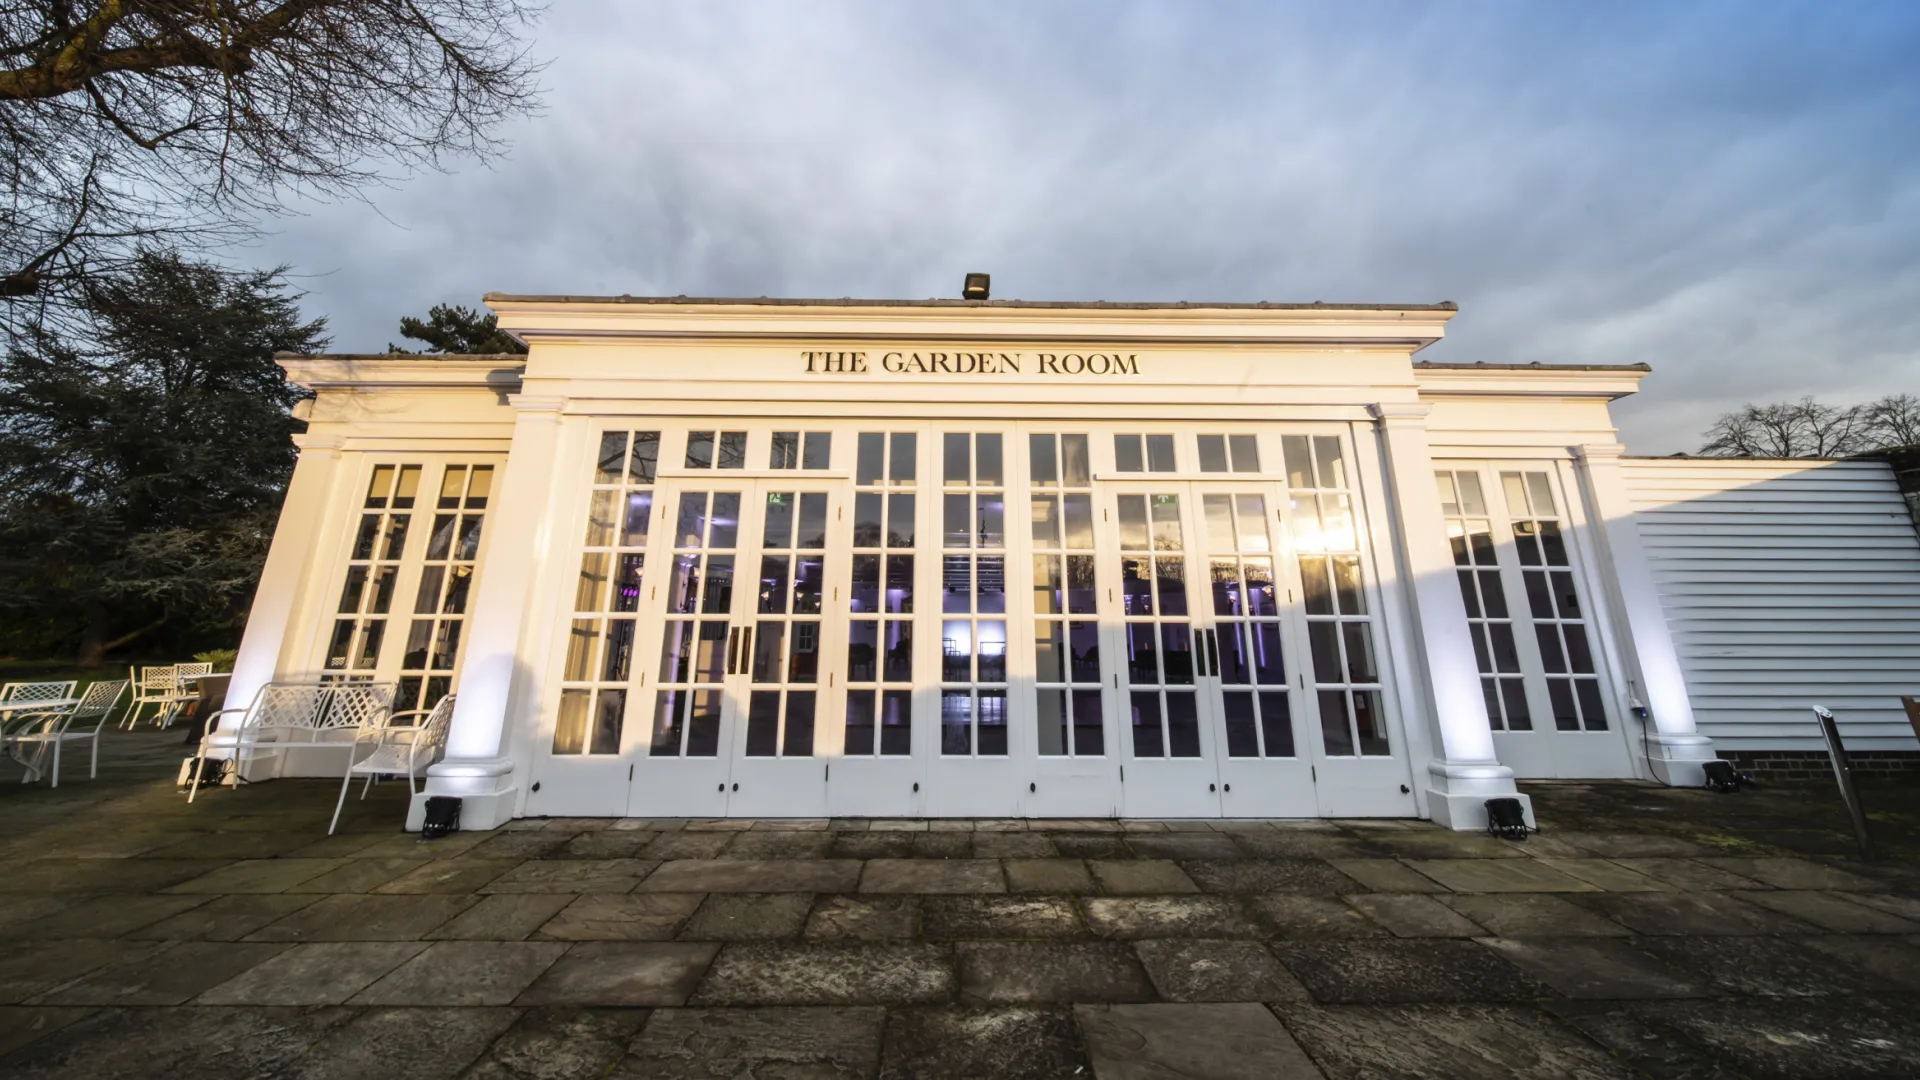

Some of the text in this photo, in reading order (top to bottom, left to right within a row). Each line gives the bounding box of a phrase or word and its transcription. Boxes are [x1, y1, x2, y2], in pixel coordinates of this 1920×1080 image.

[801, 351, 1141, 375] THE GARDEN ROOM
